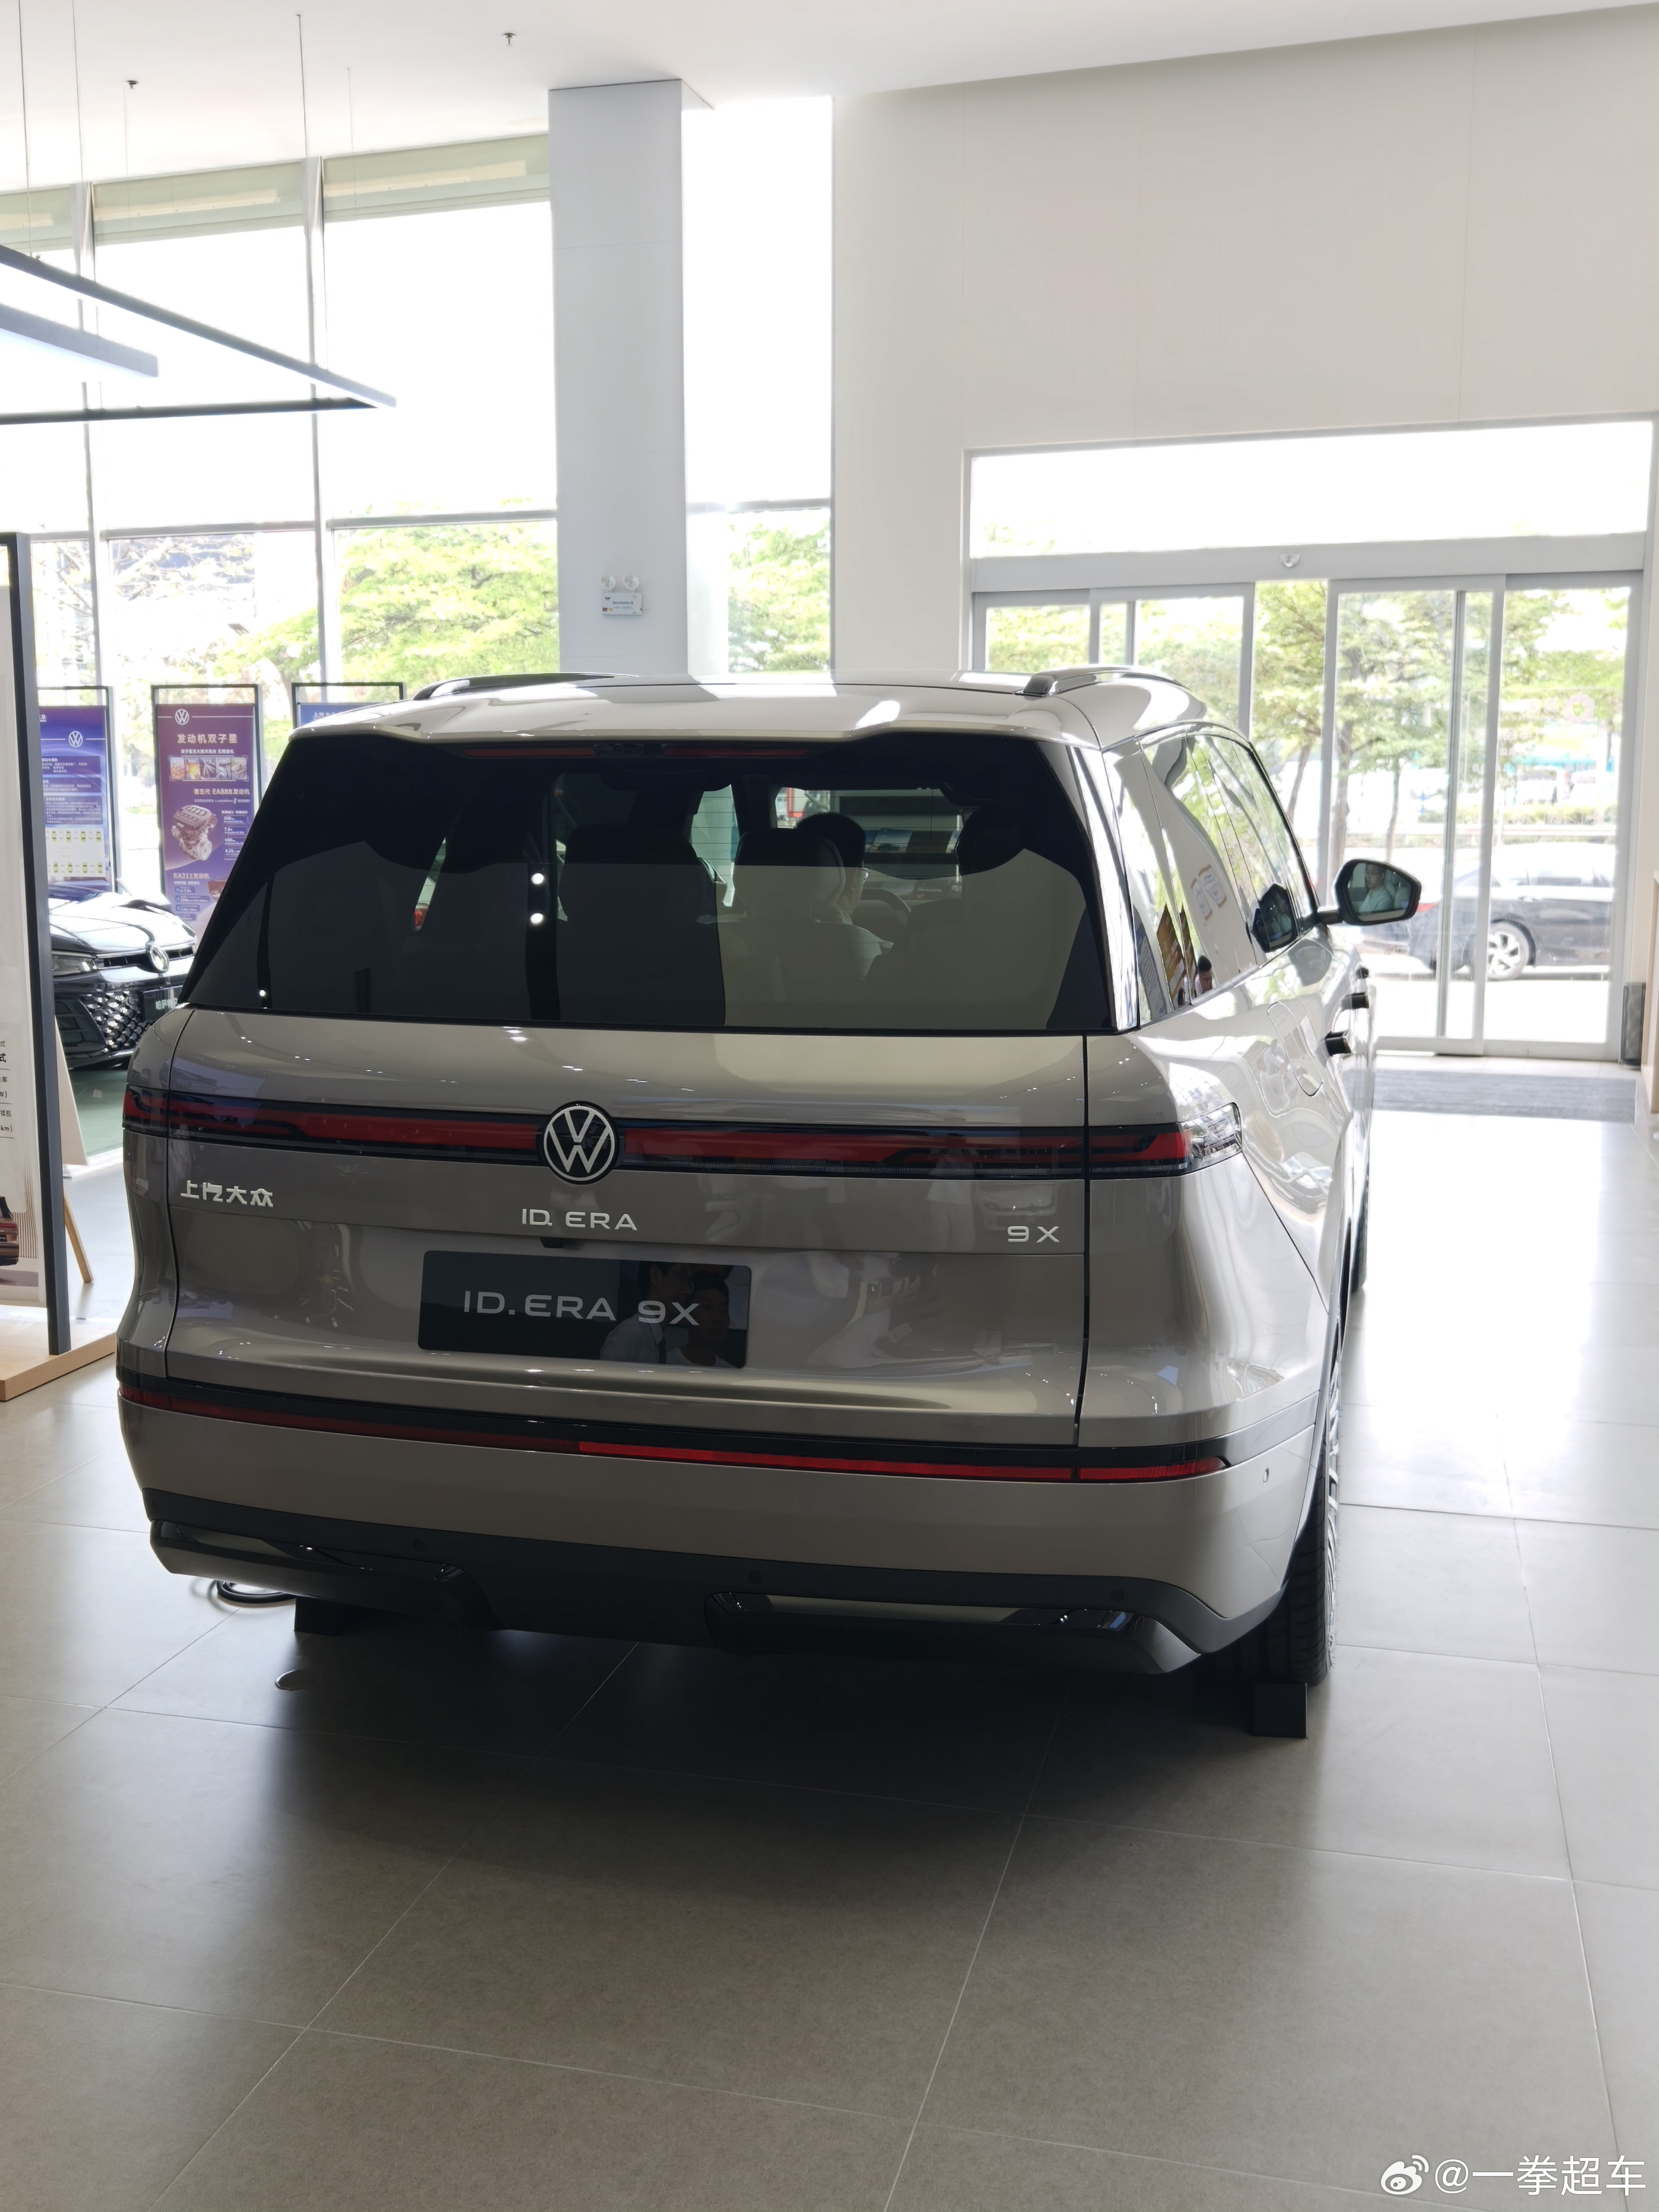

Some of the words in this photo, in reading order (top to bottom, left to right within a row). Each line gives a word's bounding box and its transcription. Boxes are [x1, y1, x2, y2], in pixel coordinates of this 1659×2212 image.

[177, 734, 237, 744] 发动机双子星
[181, 1180, 273, 1207] 上汽大众
[522, 1209, 552, 1226] ID.
[565, 1212, 638, 1231] ERA
[1007, 1226, 1059, 1243] 9X
[638, 1301, 700, 1325] 9X
